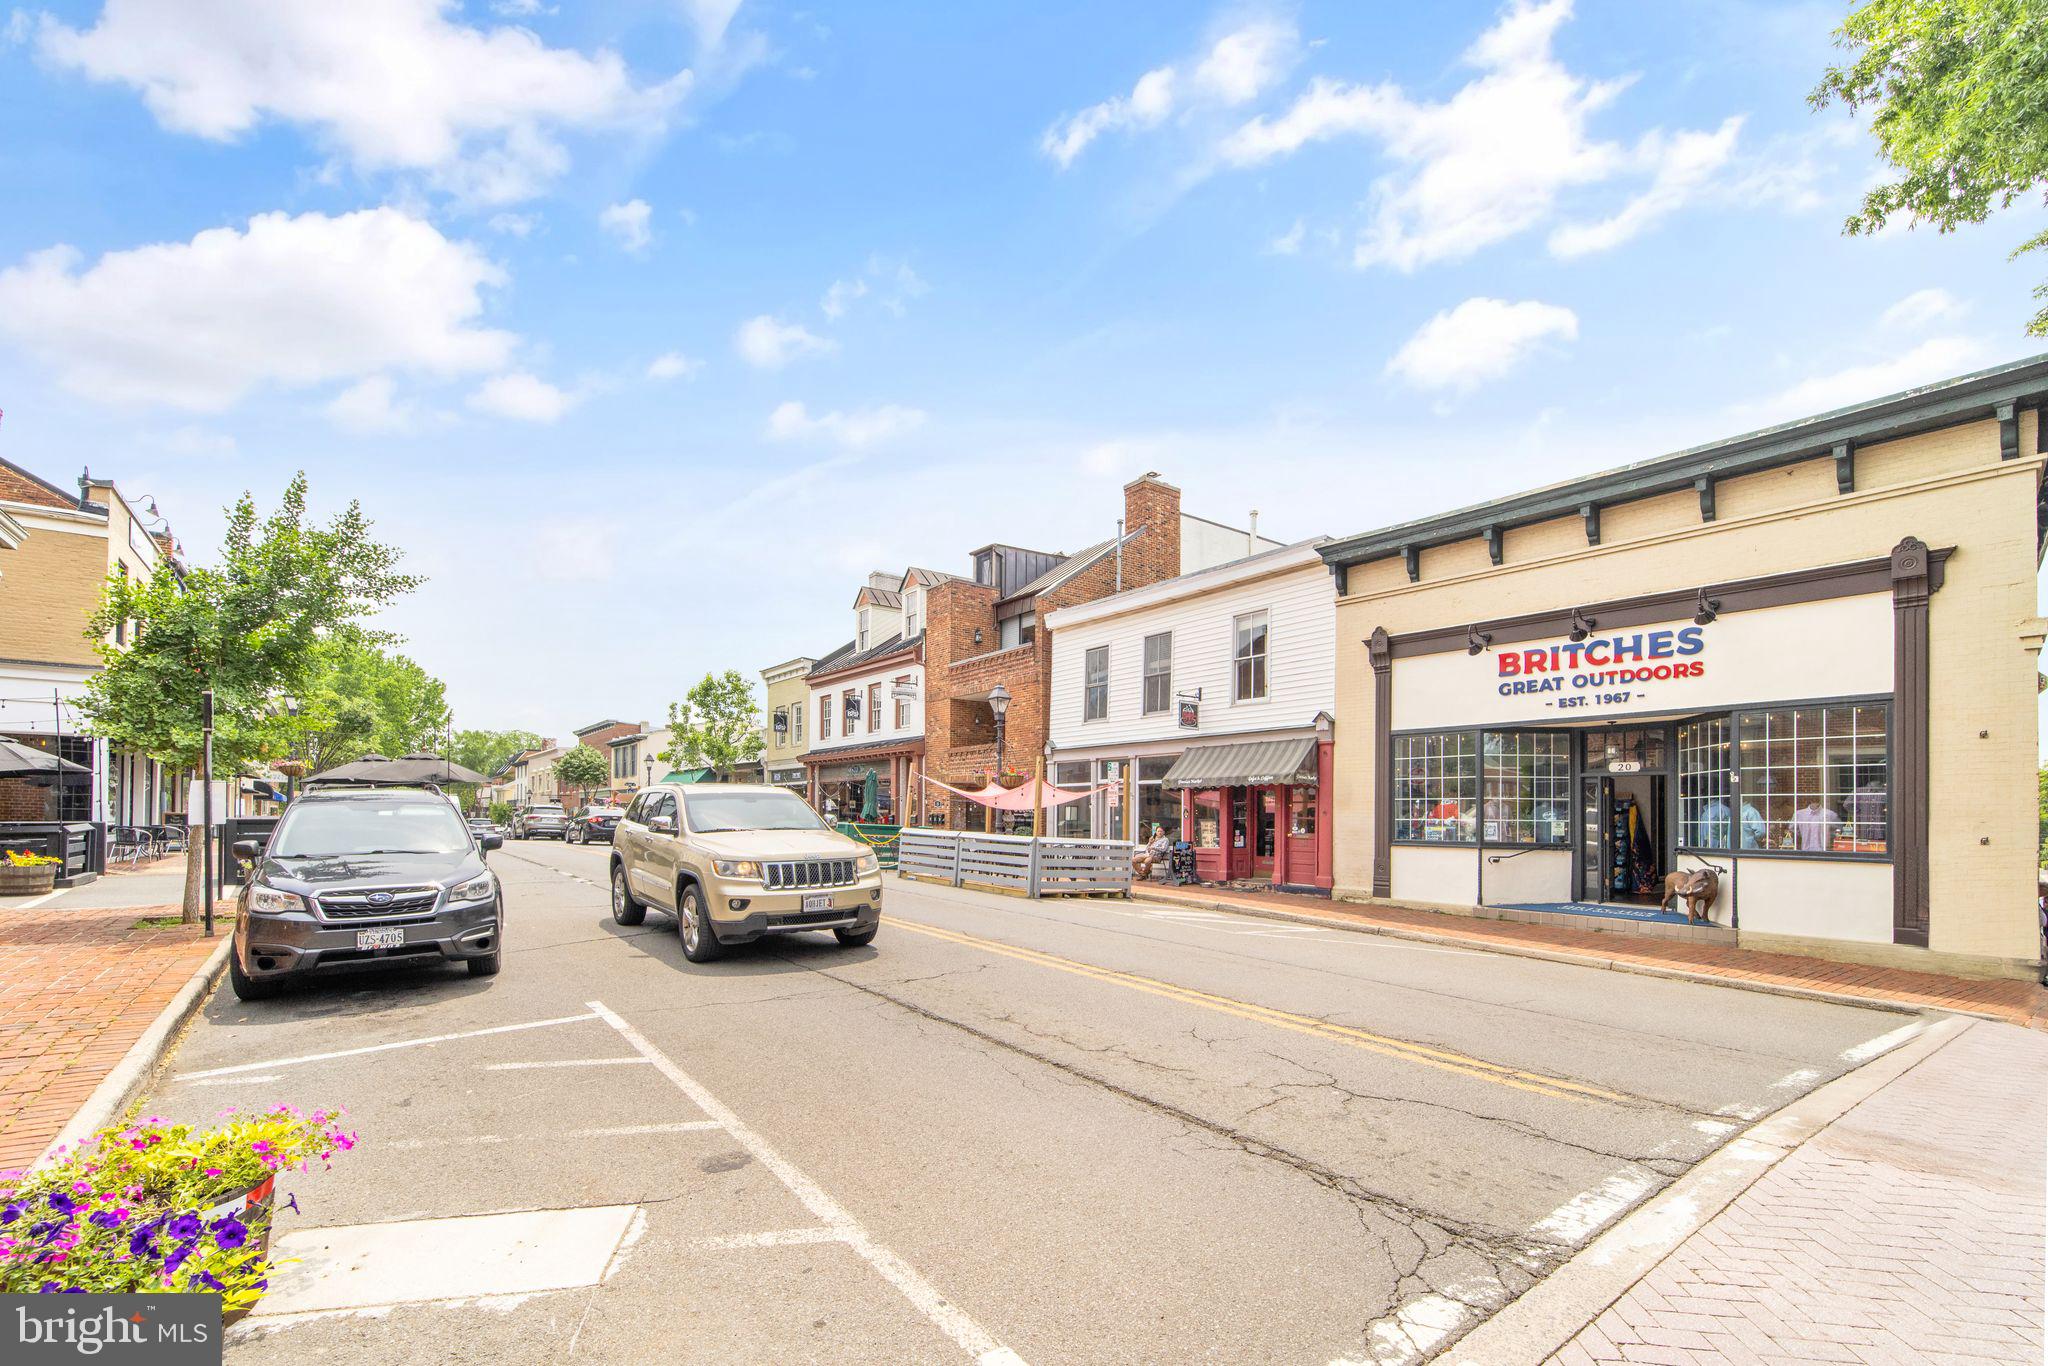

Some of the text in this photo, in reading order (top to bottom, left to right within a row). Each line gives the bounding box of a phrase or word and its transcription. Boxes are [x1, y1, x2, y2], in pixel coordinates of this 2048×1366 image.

[1498, 627, 1704, 678] BRITCHES
[1499, 661, 1705, 697] GREAT OUTDOORS
[1558, 692, 1631, 708] EST. 1967
[1617, 763, 1631, 771] 20
[359, 933, 403, 945] UZS-4705
